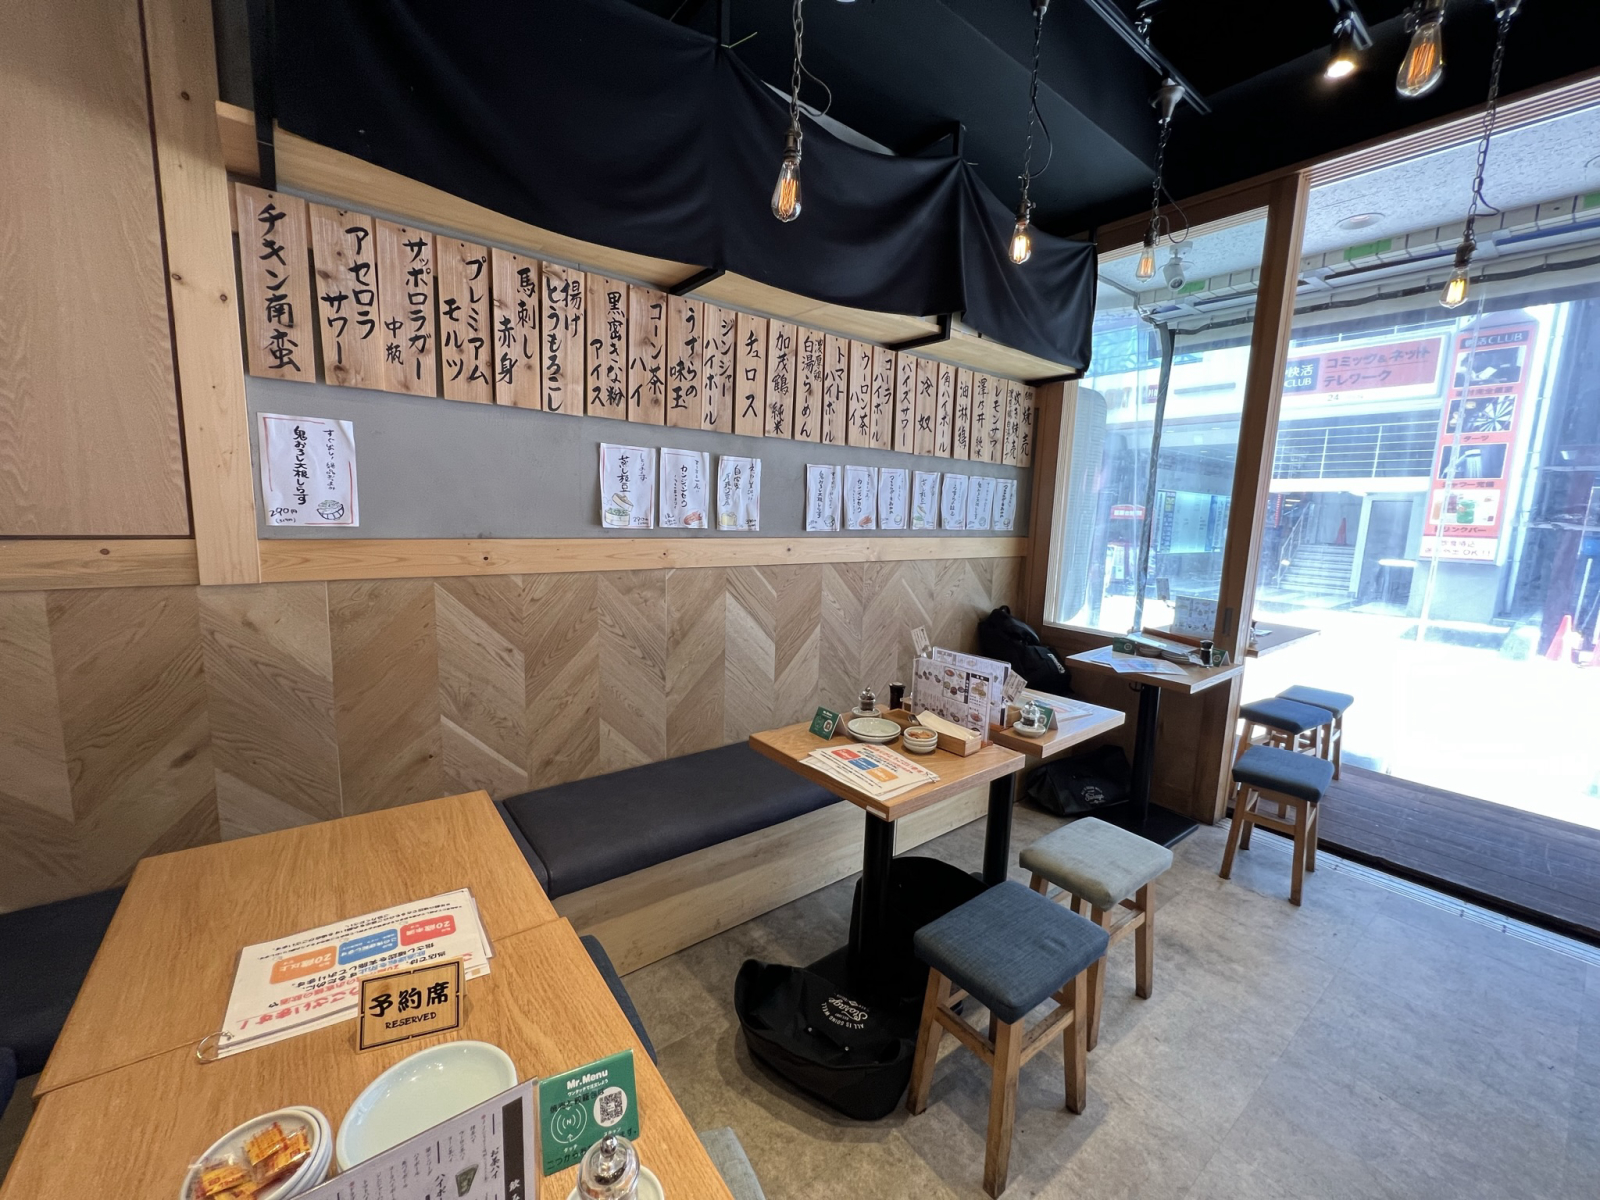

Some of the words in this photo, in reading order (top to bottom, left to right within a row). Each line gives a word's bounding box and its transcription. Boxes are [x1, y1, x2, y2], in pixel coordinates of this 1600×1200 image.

[257, 203, 301, 372] チキン南蛮
[345, 226, 376, 340] アセロラ
[402, 237, 432, 381] サッポロラガー
[515, 267, 536, 360] 馬刺し
[561, 280, 585, 338] 揚げ
[321, 292, 350, 365] サワー
[384, 316, 405, 365] 中瓶
[442, 297, 466, 382] モルツ
[465, 256, 490, 386] プレミアム
[496, 315, 518, 385] 赤身
[545, 276, 563, 412] とうもろこし
[647, 303, 664, 395] コーン茶
[684, 307, 701, 398] うずらの
[590, 338, 606, 408] アイス
[630, 357, 647, 407] ハイ
[670, 357, 688, 410] 味玉
[704, 337, 719, 425] ハイボール
[718, 318, 735, 397] ジンジャー
[743, 331, 761, 418] チュロス
[835, 346, 845, 401] トマト
[884, 358, 893, 405] コーラ
[1284, 378, 1312, 388] CLUB
[1324, 370, 1392, 388] テレワーク
[824, 370, 836, 443] ハイボール
[849, 390, 860, 426] ハイ
[859, 351, 870, 436] ウーロン茶
[872, 372, 884, 442] ハイボール
[917, 376, 934, 433] 冷奴
[957, 381, 970, 450] 油淋鶏
[990, 384, 1003, 461] レモンサワー
[292, 425, 309, 506] 鬼おろし大根しらす
[367, 981, 451, 1018] 予約席
[384, 1011, 437, 1030] RESERVED
[828, 996, 869, 1022] Storage
